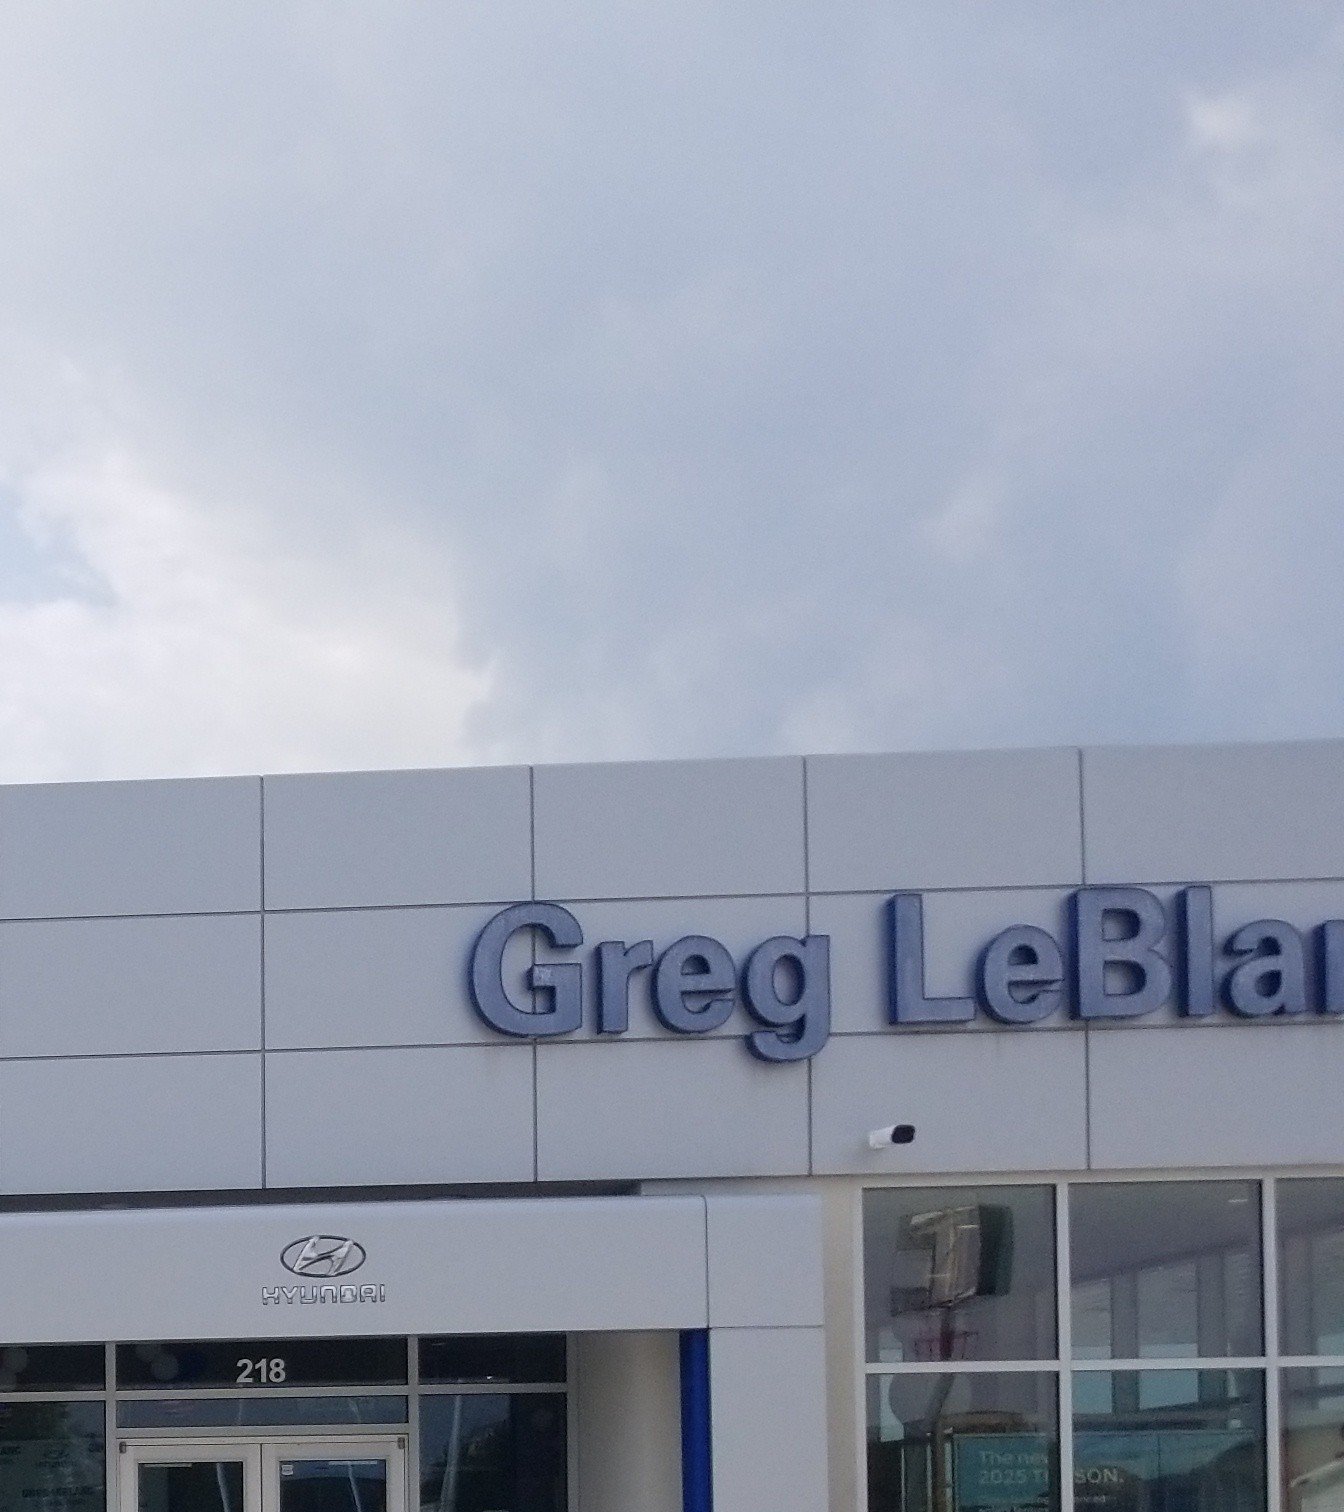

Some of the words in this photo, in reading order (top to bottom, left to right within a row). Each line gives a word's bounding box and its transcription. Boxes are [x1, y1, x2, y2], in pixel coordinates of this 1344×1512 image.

[469, 901, 831, 1063] Greg
[262, 1284, 386, 1305] HYUNDAI
[236, 1358, 286, 1383] 218
[979, 1469, 1027, 1484] 2025
